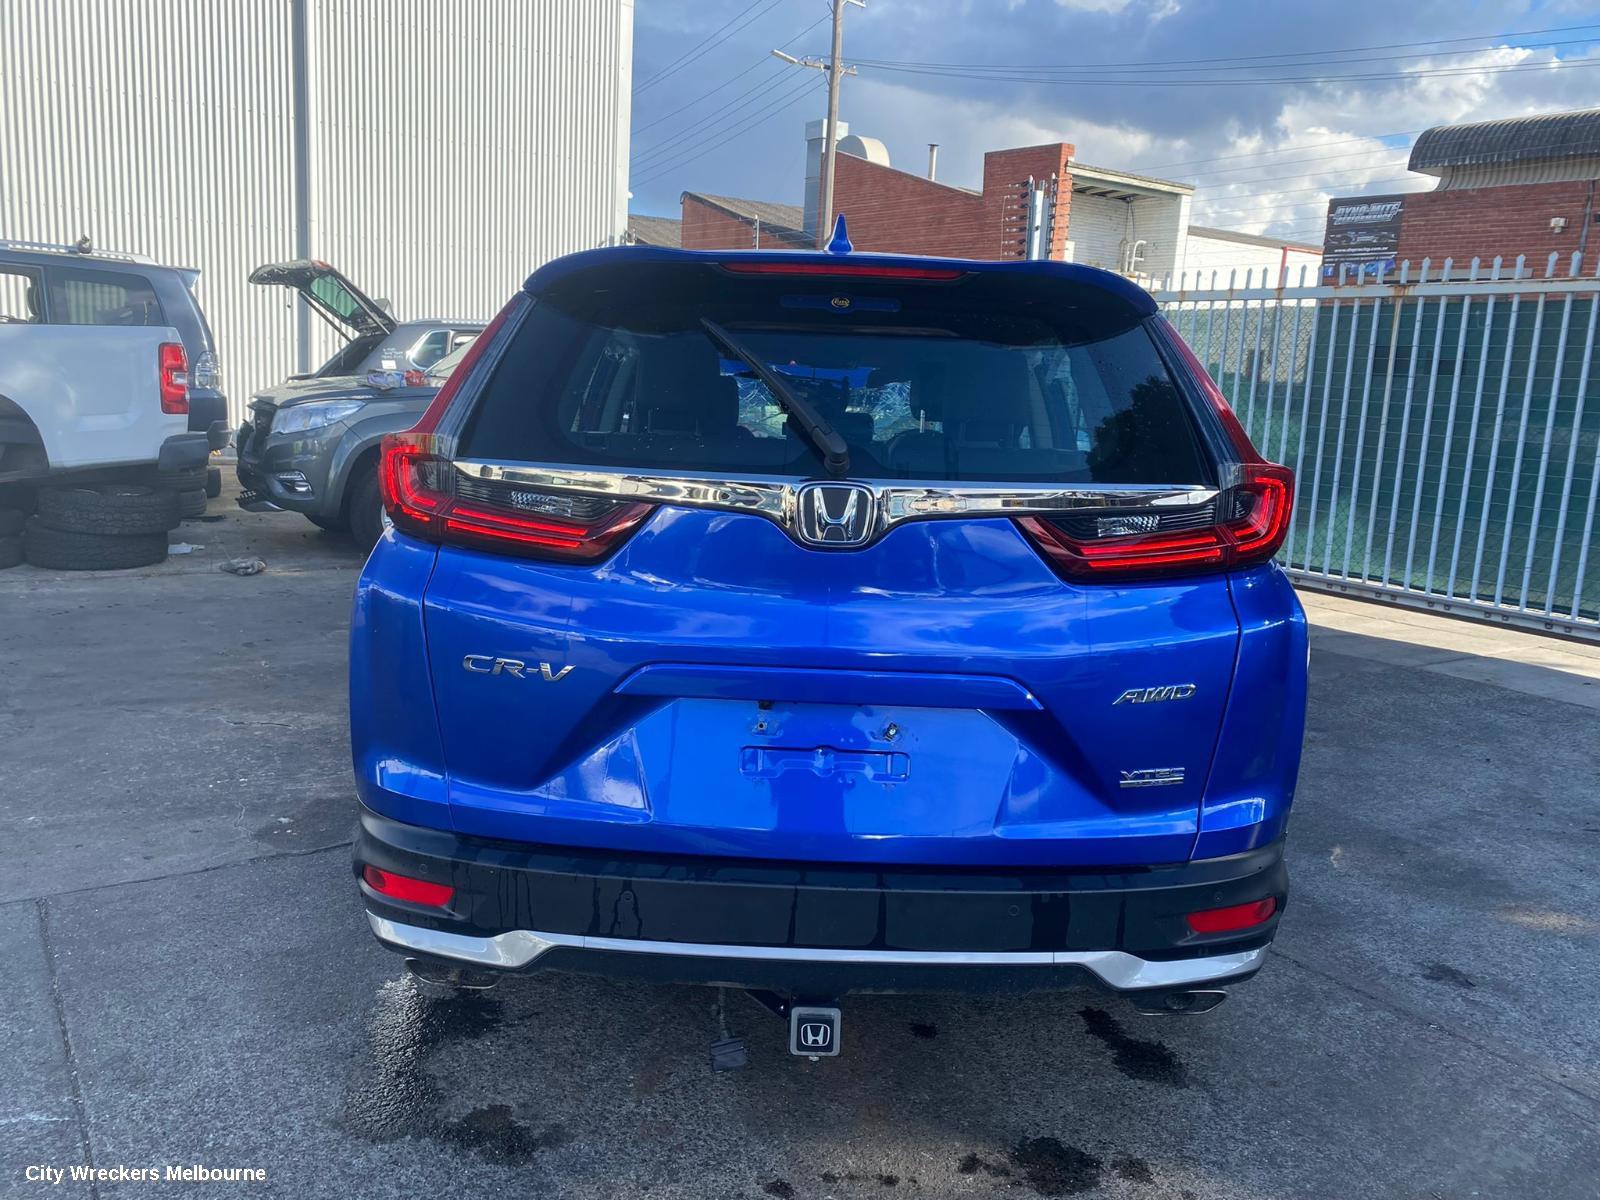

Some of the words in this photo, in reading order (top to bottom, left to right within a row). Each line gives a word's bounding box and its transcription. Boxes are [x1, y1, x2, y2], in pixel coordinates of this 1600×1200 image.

[463, 654, 577, 681] CR-V
[1112, 683, 1196, 705] AWD
[1120, 768, 1185, 780] VTEC
